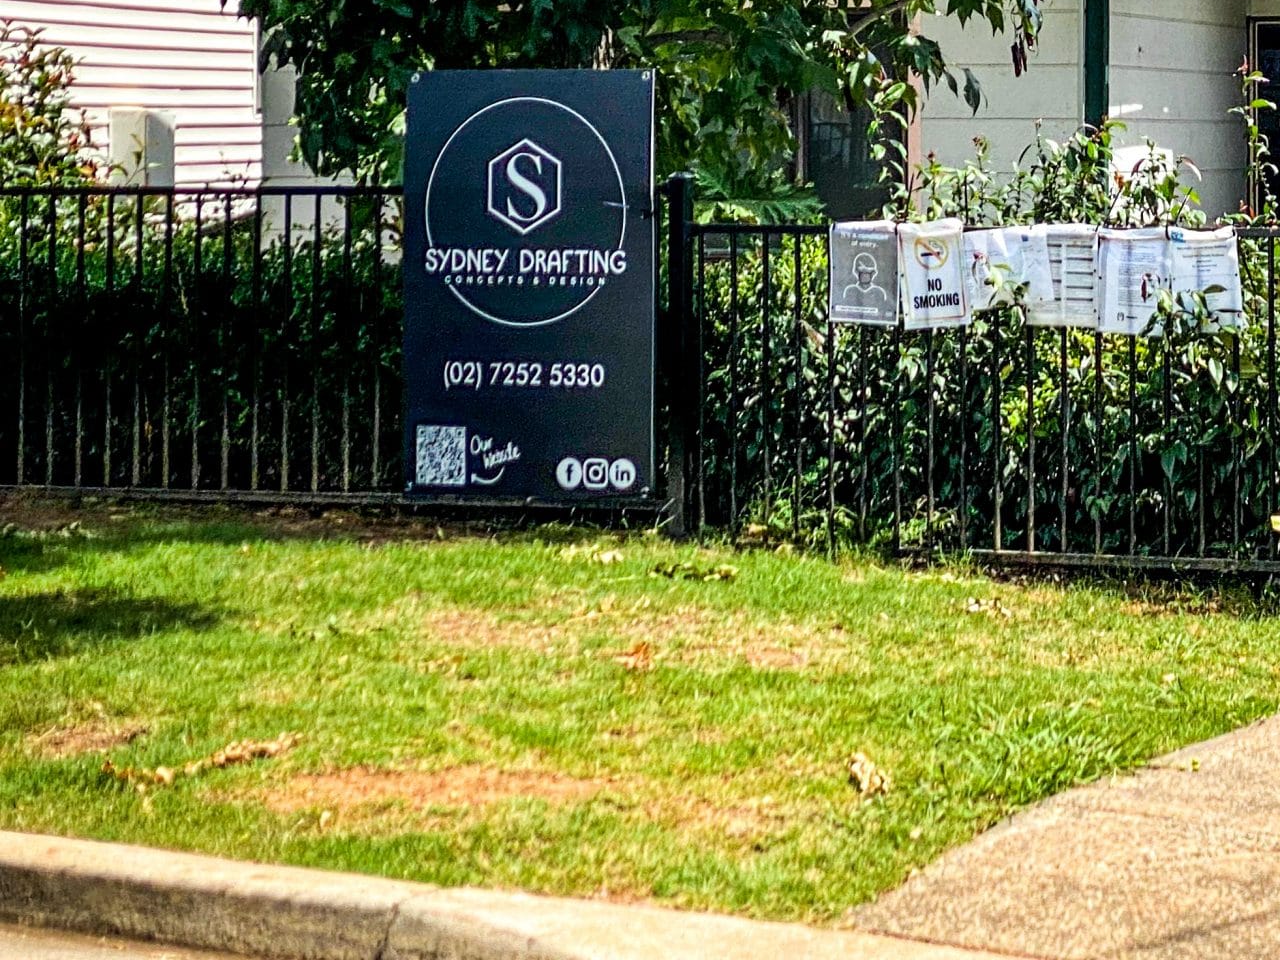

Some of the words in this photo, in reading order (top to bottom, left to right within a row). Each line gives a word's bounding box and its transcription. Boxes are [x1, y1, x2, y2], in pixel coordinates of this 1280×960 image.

[506, 152, 546, 222] S
[425, 248, 509, 273] SYDNEY
[519, 249, 627, 274] DRAFTING
[444, 275, 523, 285] CONCEPTS
[548, 276, 606, 286] DESIGN
[927, 277, 943, 291] NO
[913, 292, 960, 309] SMOKING
[443, 360, 482, 391] (02)
[489, 362, 542, 386] 7252
[549, 363, 605, 388] 5330
[470, 434, 493, 455] Our
